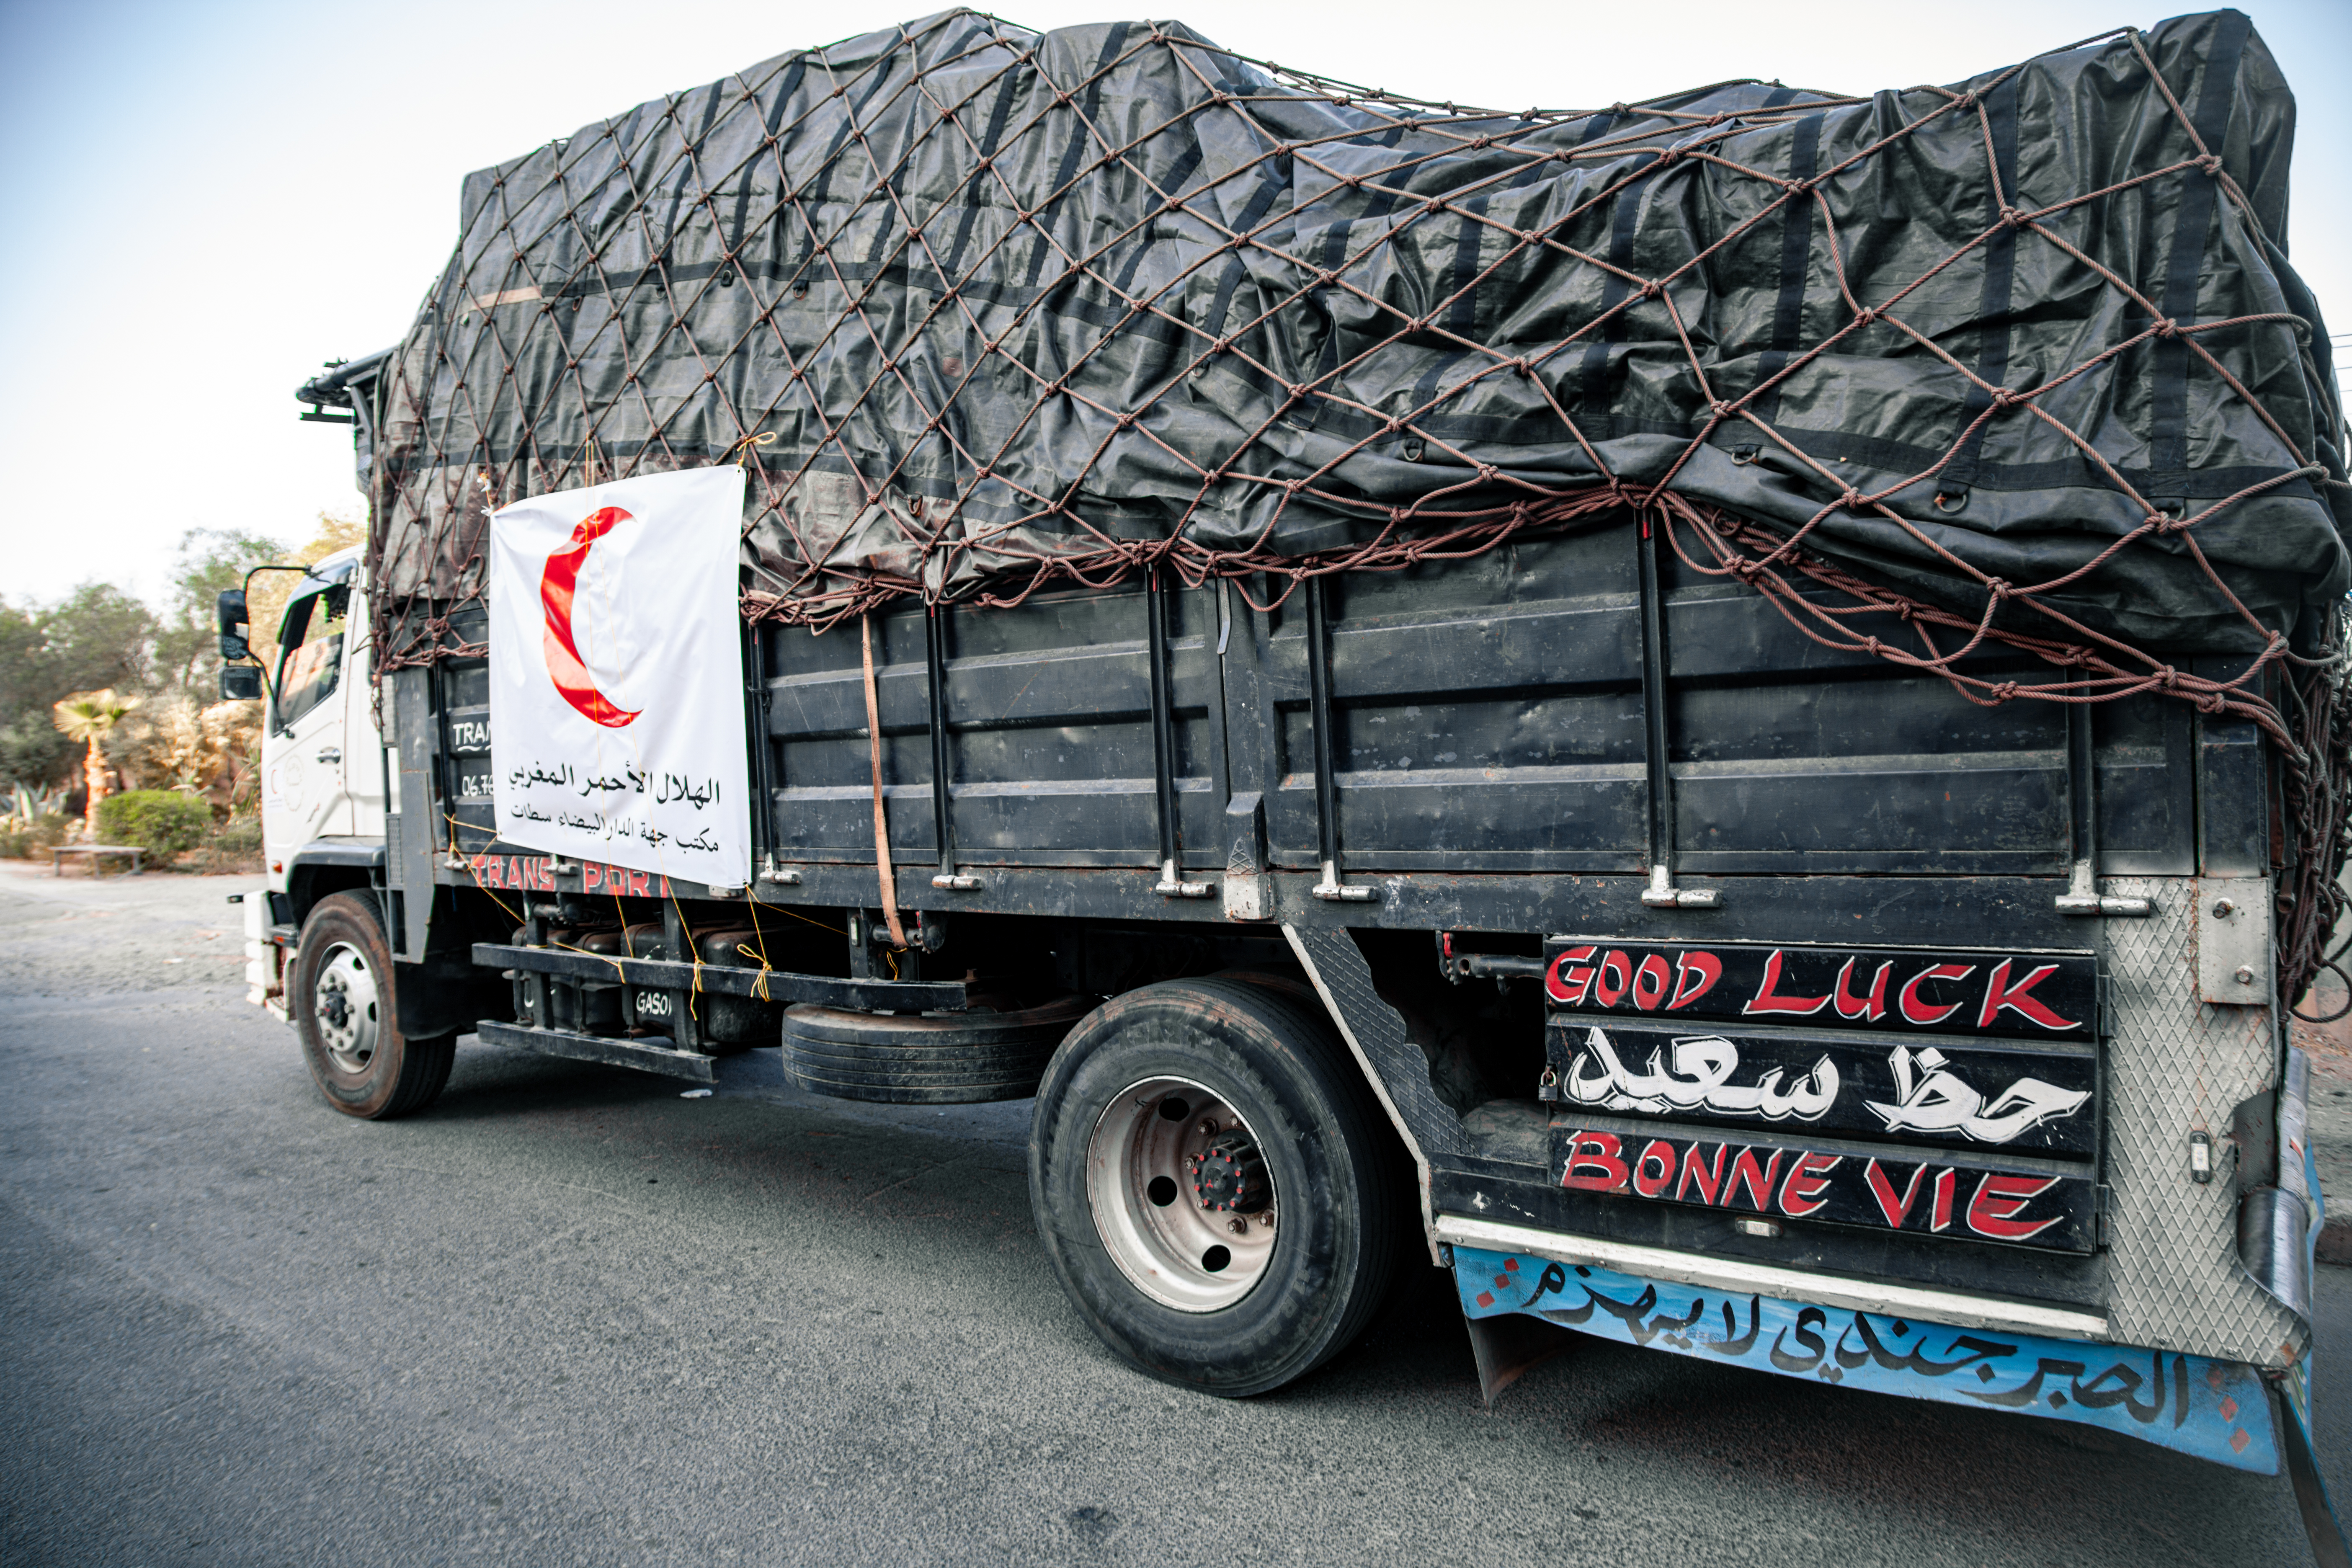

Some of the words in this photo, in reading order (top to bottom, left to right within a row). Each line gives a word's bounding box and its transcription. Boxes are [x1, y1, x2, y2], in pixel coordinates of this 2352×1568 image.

[509, 761, 574, 791] المغربي
[577, 761, 653, 797] الأحمر
[656, 771, 720, 811] الهلال
[511, 802, 551, 822] سطات
[559, 811, 605, 836] البيضاء
[606, 817, 634, 841] الدار
[641, 822, 668, 848] جهة
[676, 827, 719, 855] مكتب
[1545, 946, 1722, 1011] GOOD
[1741, 948, 2082, 1030] LUCK
[1213, 1038, 1304, 1142] ENERGY
[1564, 1026, 1839, 1122] سعيد
[1862, 1044, 2092, 1145] حظ
[1560, 1130, 1843, 1216] BONNE
[1863, 1157, 2064, 1241] VIE
[1954, 1349, 2190, 1430] الصبر
